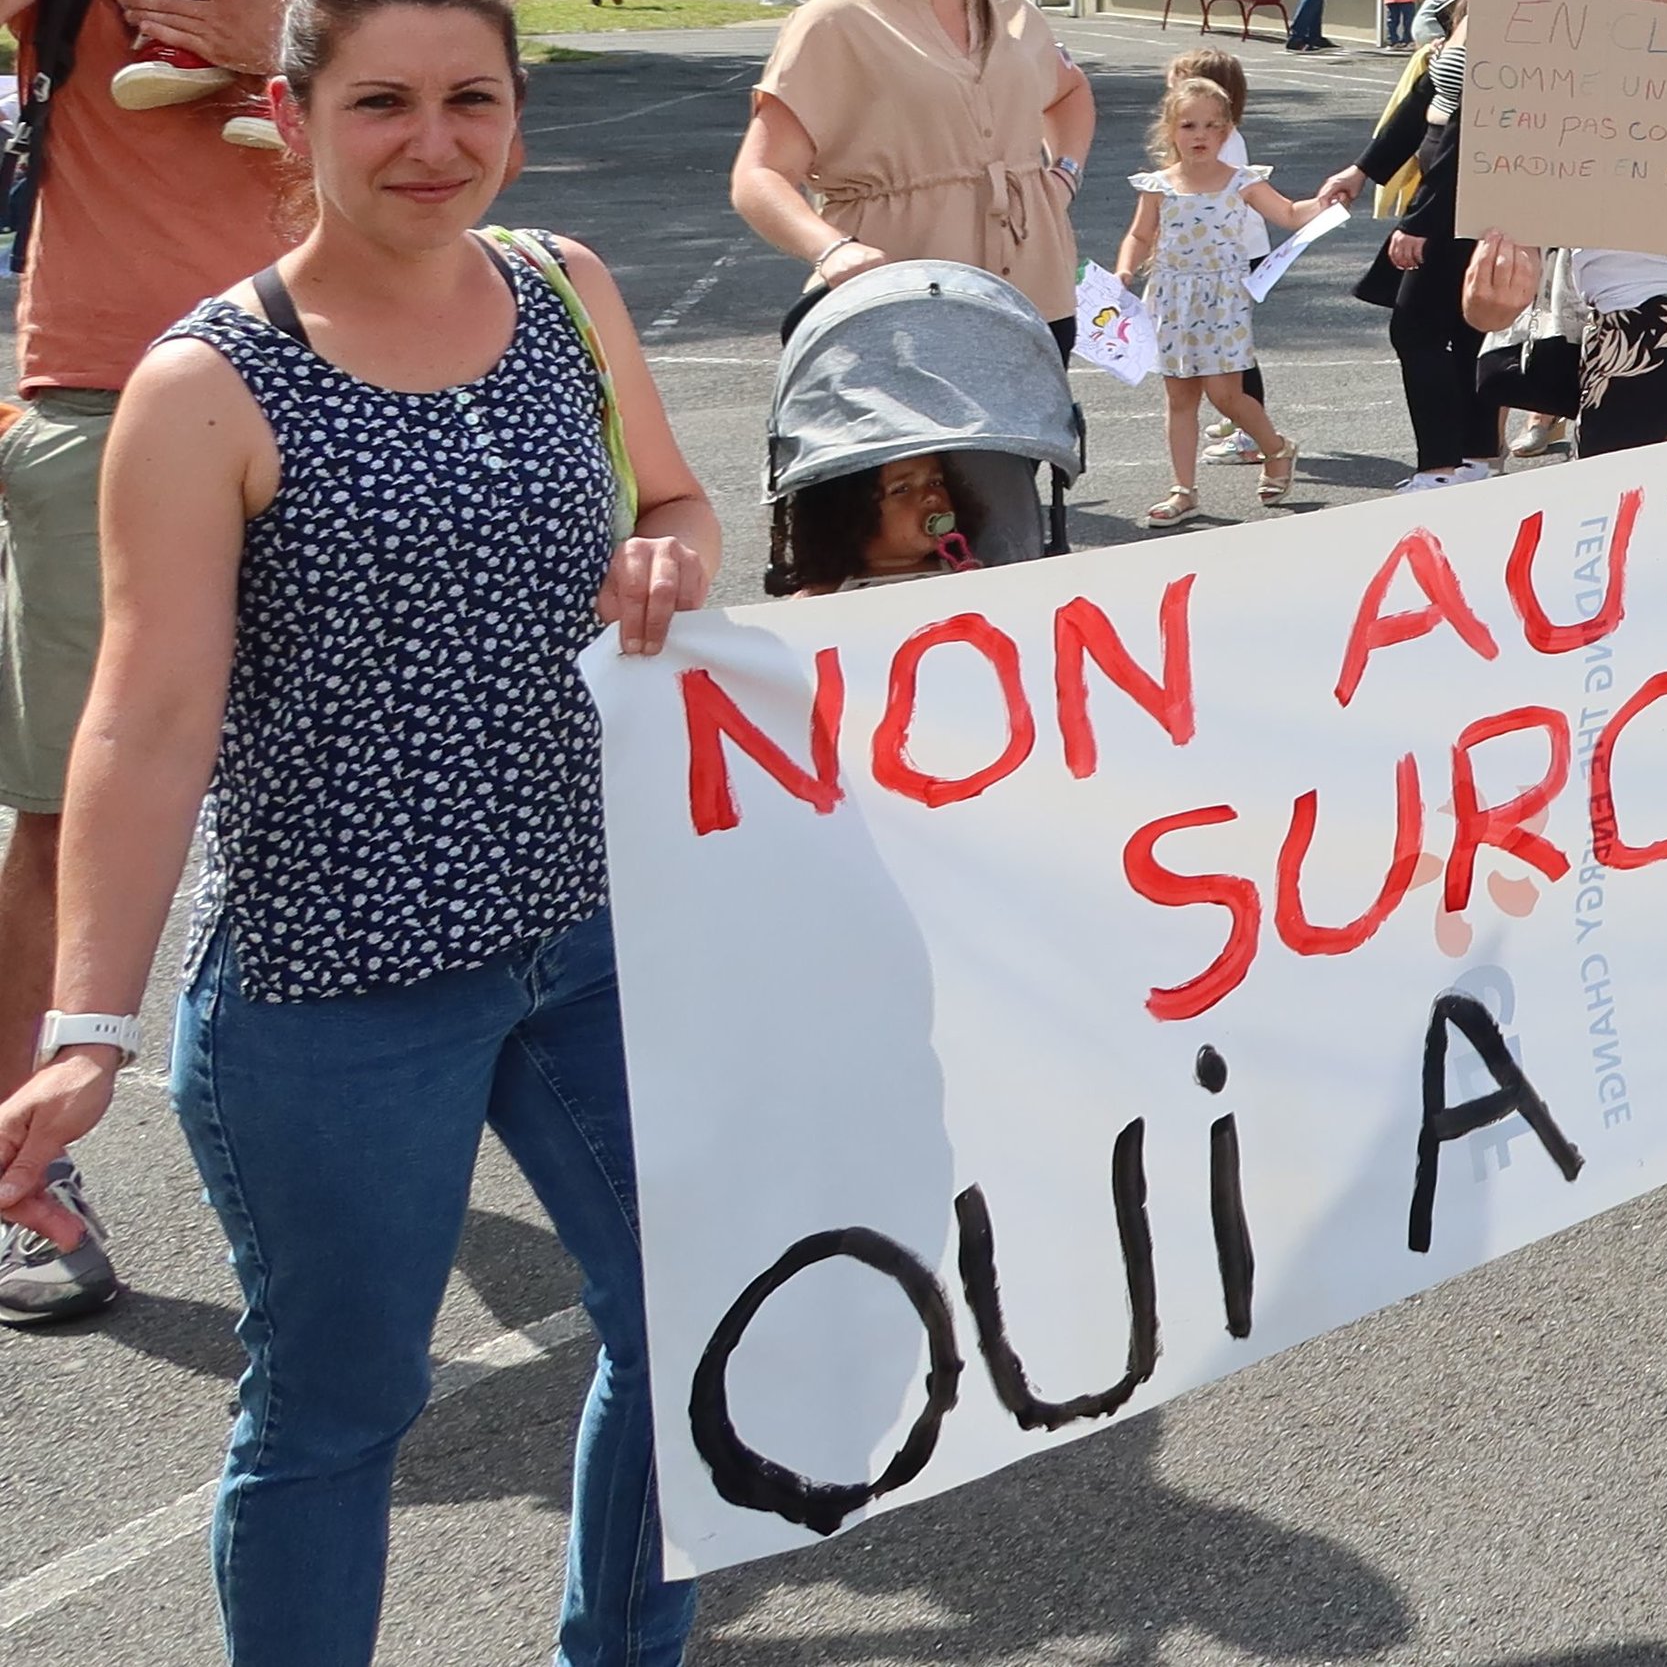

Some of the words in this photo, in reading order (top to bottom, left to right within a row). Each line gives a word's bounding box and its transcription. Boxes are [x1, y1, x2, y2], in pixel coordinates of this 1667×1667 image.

[1471, 59, 1602, 99] COMME
[1621, 74, 1667, 101] UN
[1473, 107, 1547, 131] L'EAU
[1557, 114, 1618, 147] PAS
[1473, 150, 1596, 179] SARDINE
[1613, 159, 1649, 180] EN
[679, 572, 1198, 837] NON
[1407, 991, 1587, 1254] A
